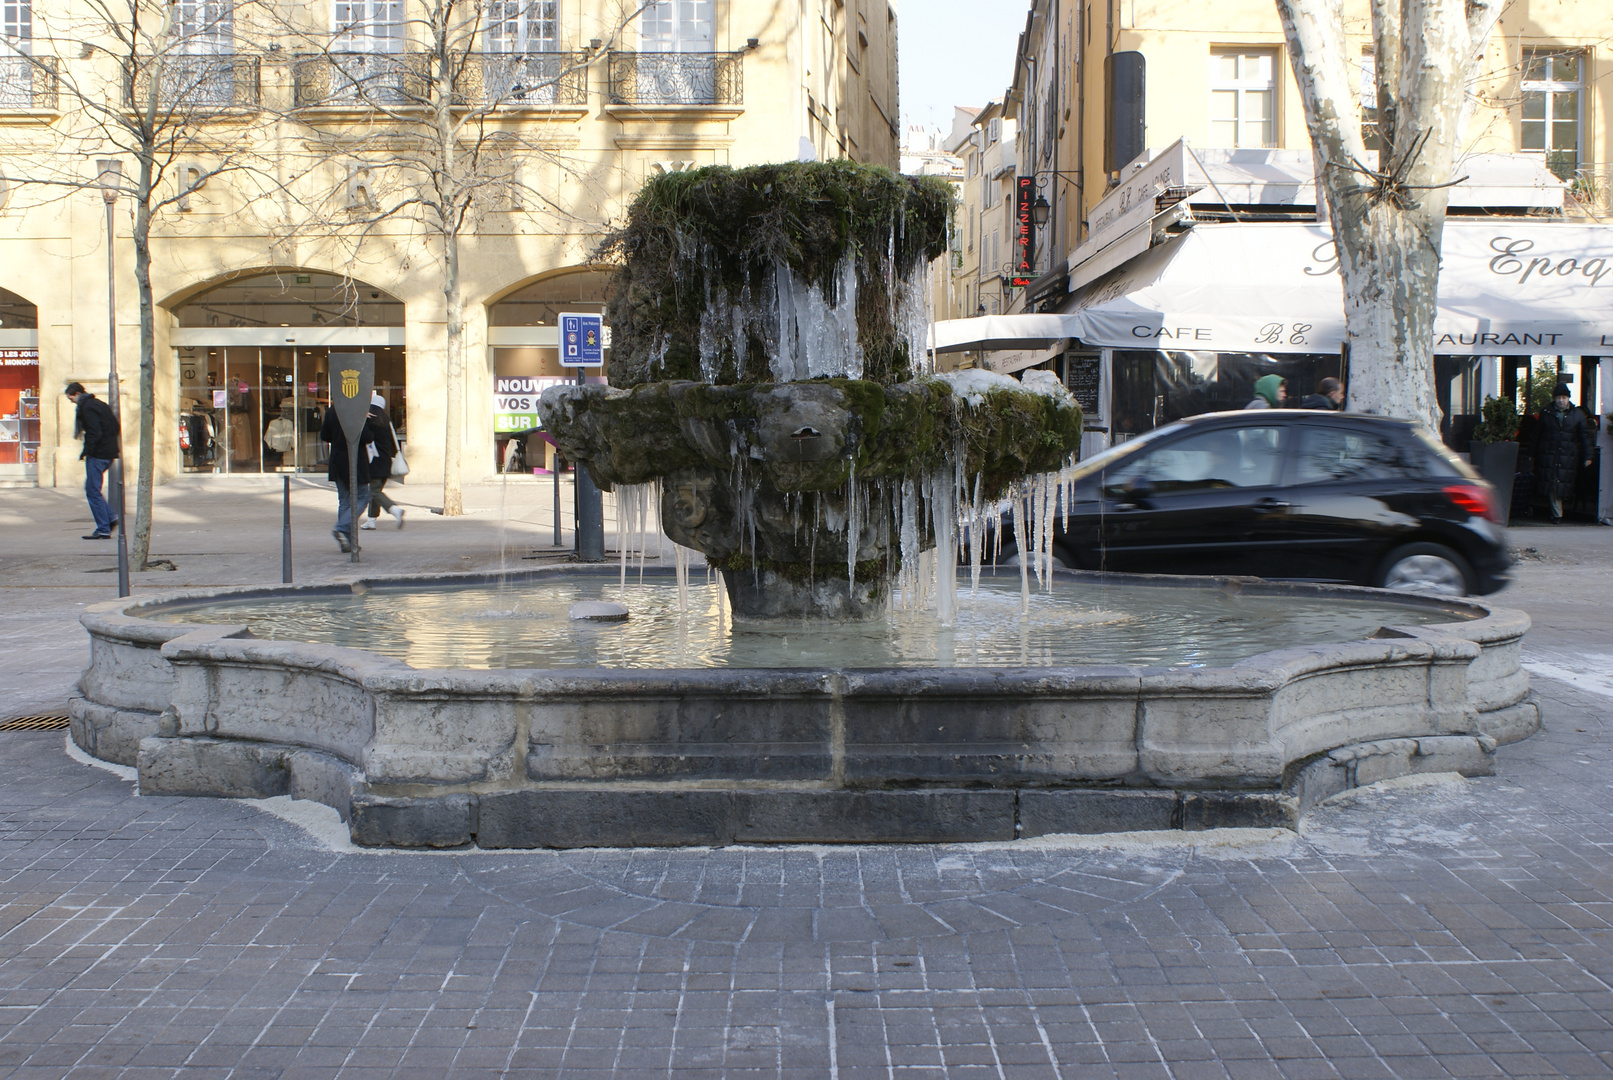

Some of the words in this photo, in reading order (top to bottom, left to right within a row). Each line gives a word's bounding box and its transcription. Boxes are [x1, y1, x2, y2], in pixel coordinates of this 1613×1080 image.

[1019, 179, 1031, 270] PIZZERIA
[1488, 236, 1613, 287] Epoq
[1131, 325, 1213, 341] CAFE
[1433, 333, 1564, 347] AURANT
[498, 398, 531, 410] VOS
[497, 416, 531, 430] SUR
